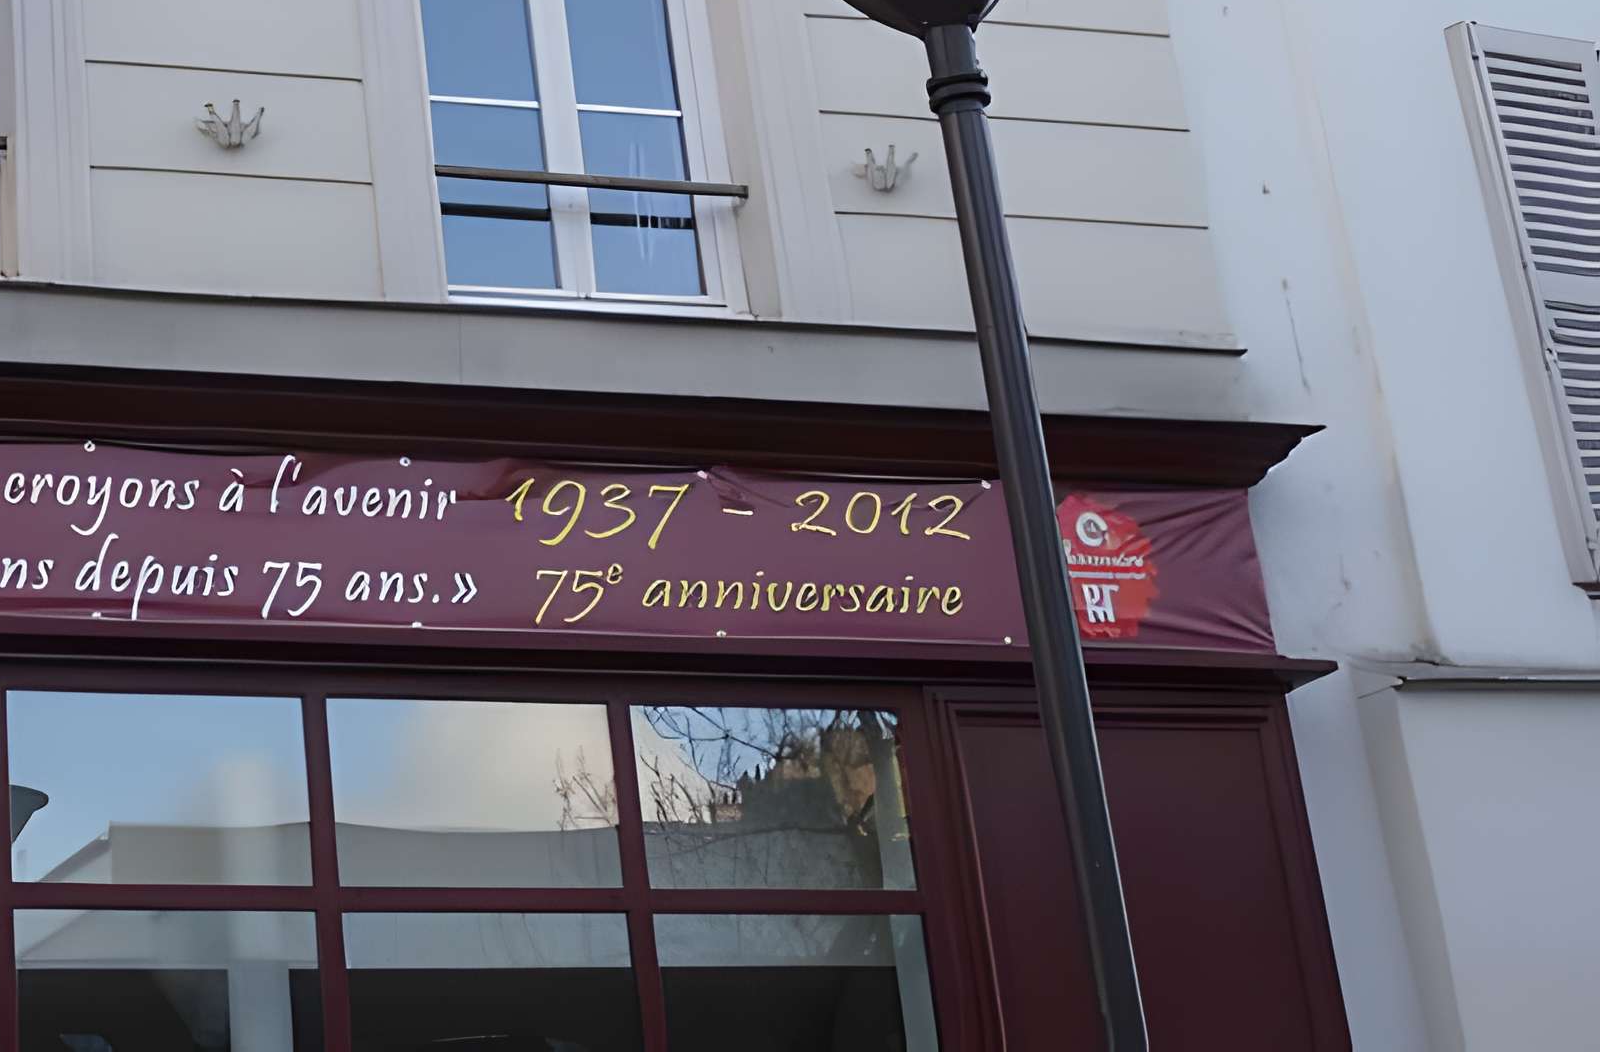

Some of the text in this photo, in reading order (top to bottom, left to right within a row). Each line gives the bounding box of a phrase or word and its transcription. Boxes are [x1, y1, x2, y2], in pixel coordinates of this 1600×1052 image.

[2, 470, 200, 536] croyons
[217, 468, 245, 513] à
[268, 454, 458, 521] l'avenir
[504, 477, 690, 550] 1937
[790, 490, 971, 541] 2012
[74, 533, 239, 621] depuis
[260, 560, 324, 619] 75
[641, 569, 964, 617] anniversaire
